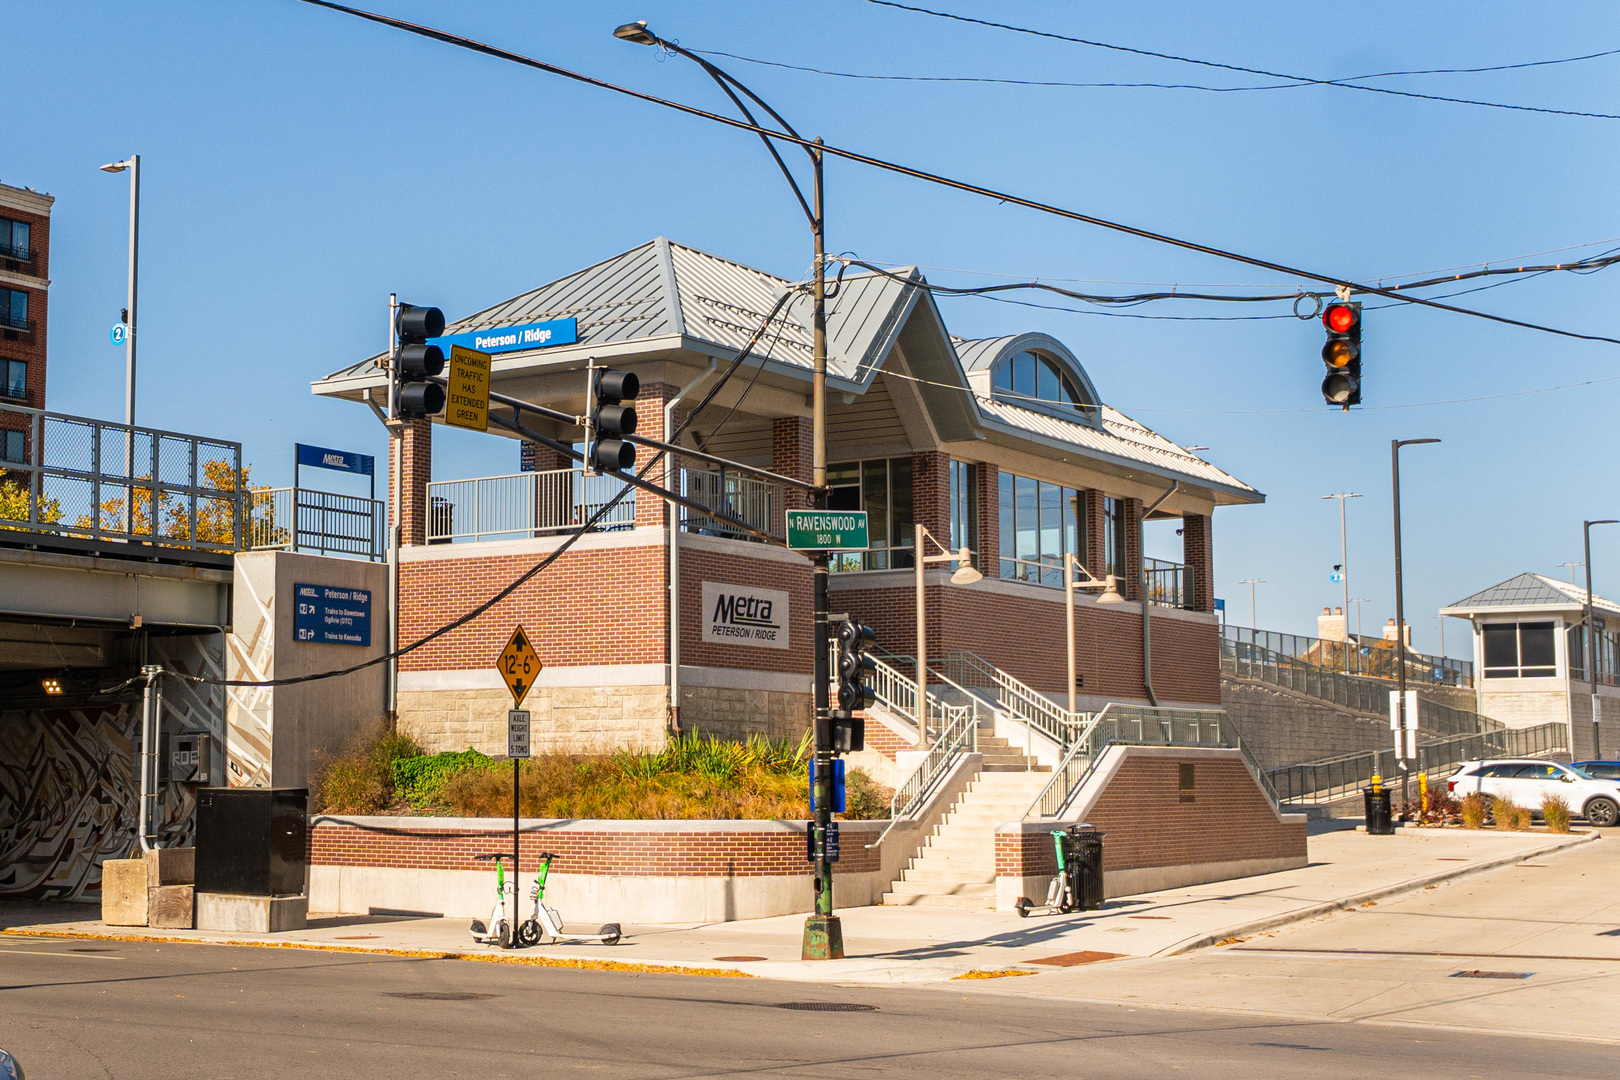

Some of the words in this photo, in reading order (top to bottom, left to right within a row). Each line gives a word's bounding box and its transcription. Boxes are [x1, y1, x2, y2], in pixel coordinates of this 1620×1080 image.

[115, 328, 121, 340] 2
[475, 334, 516, 349] Peterson
[518, 331, 523, 344] /
[524, 328, 552, 343] Ridge
[454, 354, 487, 370] ONCOMING
[457, 368, 483, 383] TRAFFIC
[462, 383, 476, 394] HAS
[451, 395, 485, 410] EXTENDED
[456, 409, 479, 422] GREEN
[322, 453, 346, 466] Metra
[789, 518, 794, 528] N
[796, 516, 855, 531] RAVENSWOOD
[857, 519, 865, 528] AV
[816, 534, 832, 544] 1800
[835, 534, 841, 544] W
[300, 587, 317, 596] Metra
[324, 589, 349, 600] Peterson
[352, 591, 368, 603] Ridge
[324, 607, 339, 615] Trains
[344, 609, 365, 617] Downtown
[713, 594, 777, 627] Metra
[324, 616, 339, 624] Ogilvie
[340, 617, 352, 626] (OTC)
[324, 632, 338, 640] Trains
[344, 634, 361, 642] Kenosha
[712, 625, 750, 638] PETERSON
[755, 629, 776, 640] RIDGE
[512, 714, 525, 722] AXLE
[511, 724, 528, 733] WEIGHT
[512, 734, 525, 742] LIMIT
[510, 745, 514, 753] 5
[515, 745, 528, 753] TONS
